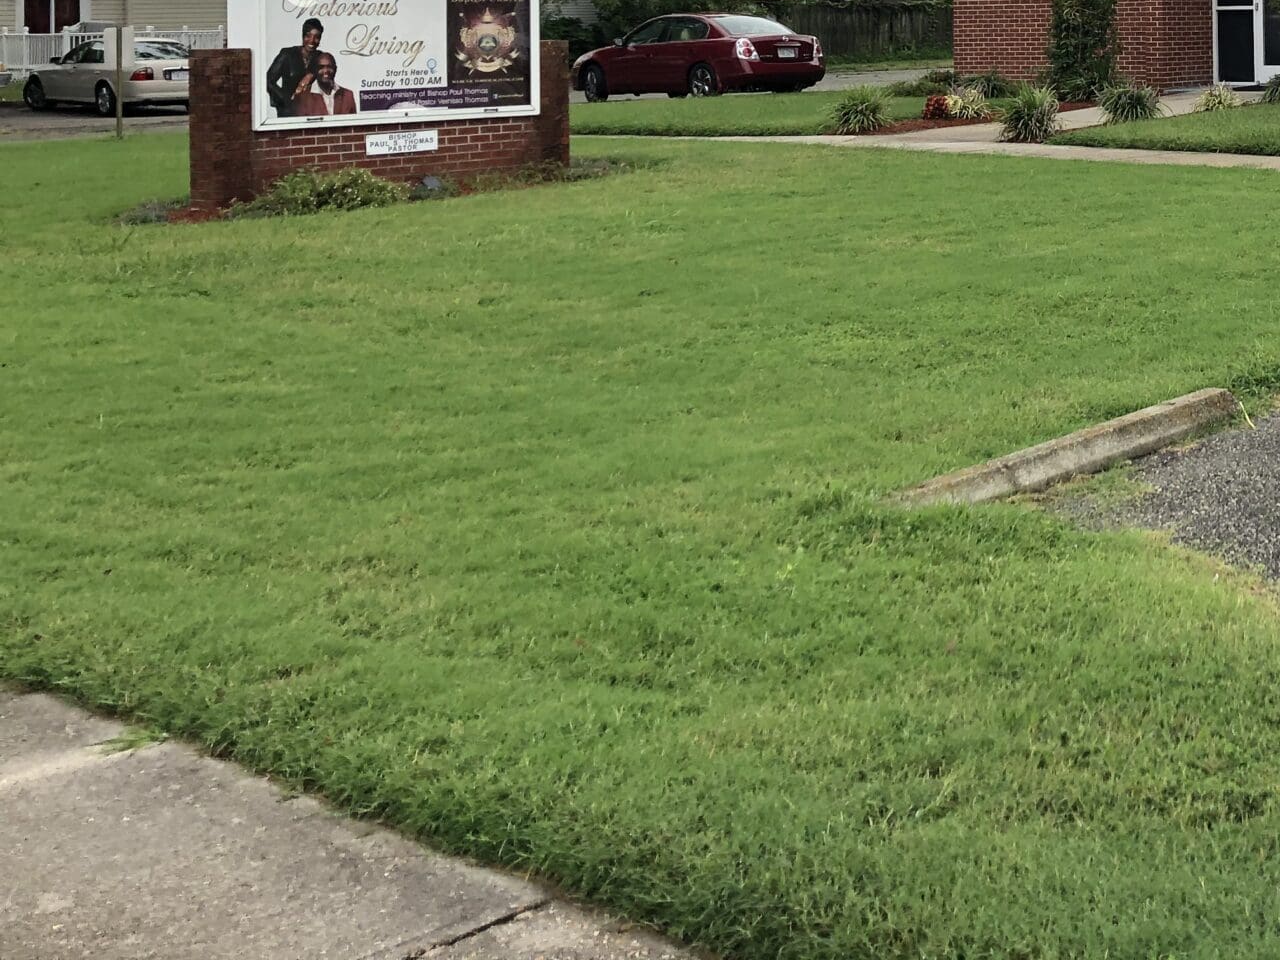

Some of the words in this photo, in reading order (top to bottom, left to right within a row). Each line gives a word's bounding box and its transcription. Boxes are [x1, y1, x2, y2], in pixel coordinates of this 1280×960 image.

[339, 23, 426, 68] Living
[386, 69, 408, 77] Starts
[360, 79, 396, 88] Sunday
[427, 76, 442, 85] AM
[361, 92, 391, 101] Teaching
[392, 91, 418, 100] ministry
[427, 89, 448, 98] Bishop
[449, 88, 463, 96] Paul
[464, 96, 489, 104] Thomas
[388, 133, 417, 141] BISHOP
[404, 137, 434, 145] THOMAS
